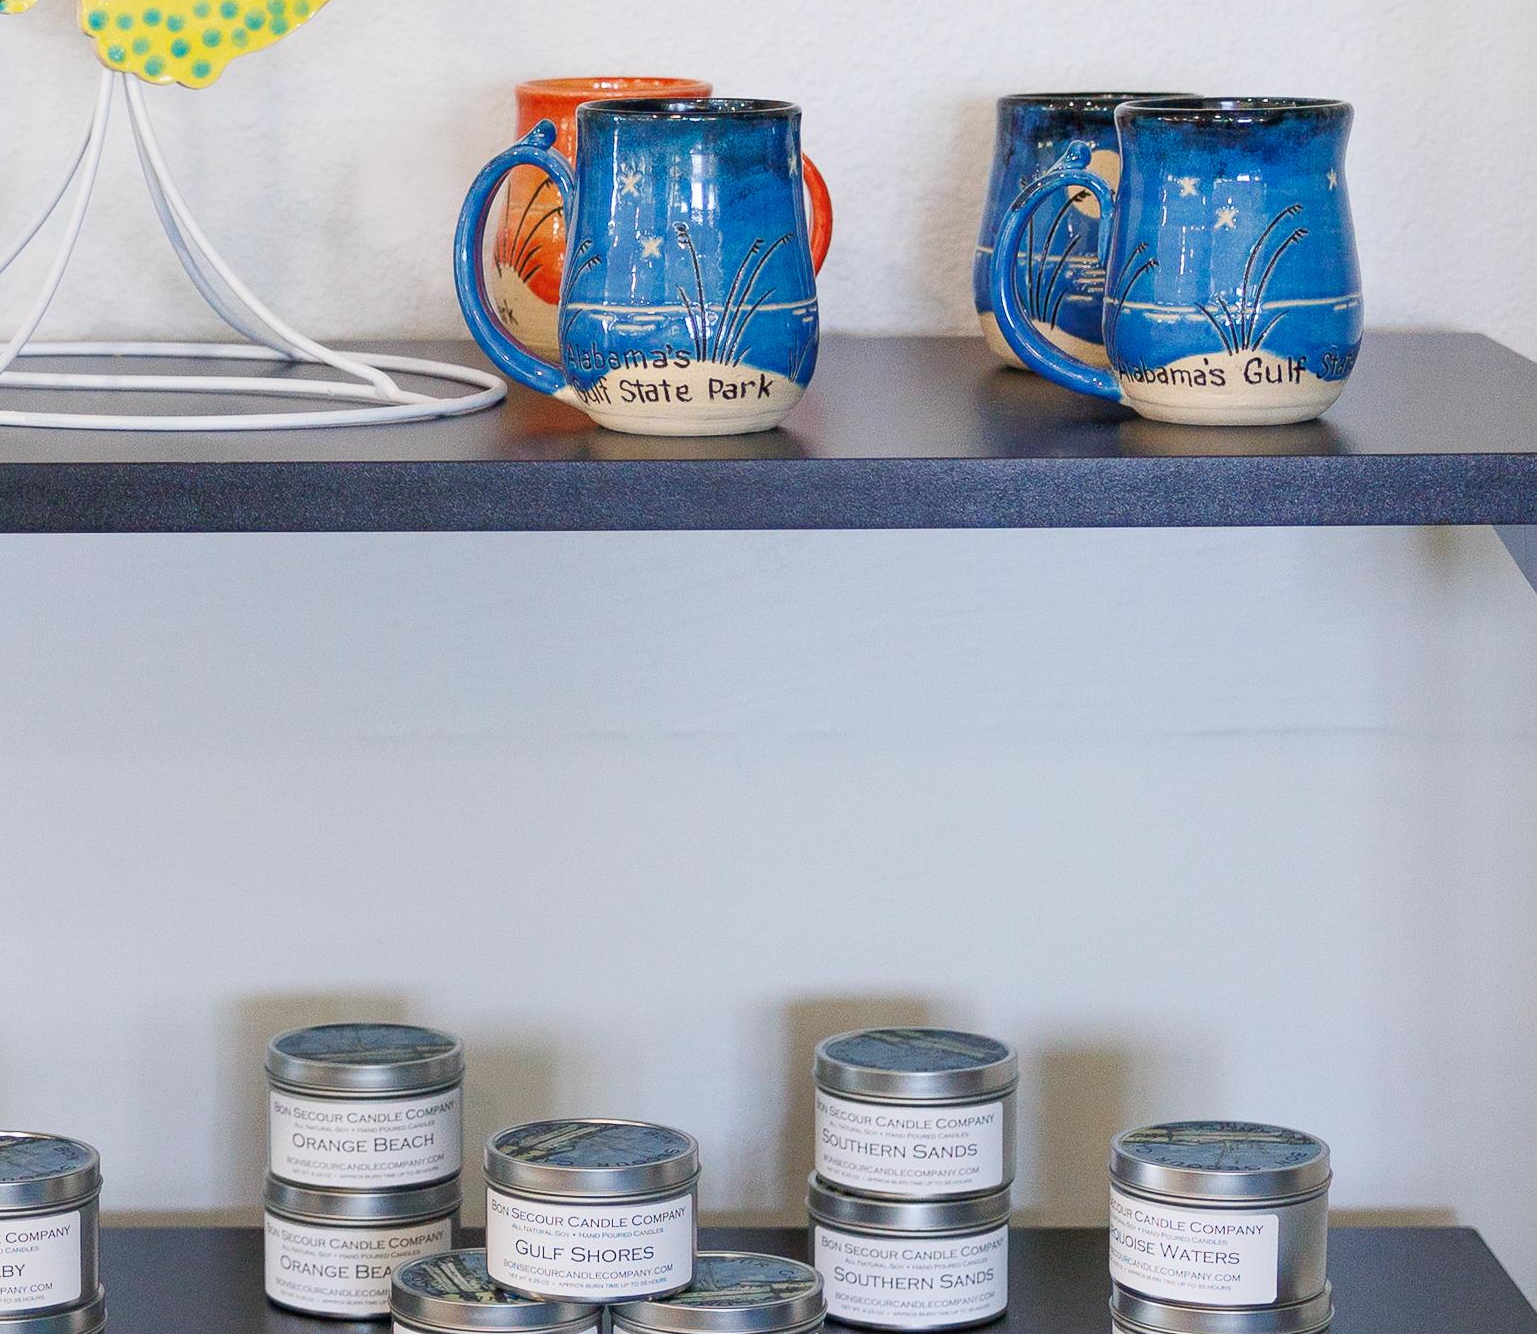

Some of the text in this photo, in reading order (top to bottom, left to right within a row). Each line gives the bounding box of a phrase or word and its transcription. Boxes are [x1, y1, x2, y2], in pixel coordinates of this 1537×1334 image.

[566, 341, 692, 371] Alabama's
[1118, 357, 1226, 387] Alabama's
[1243, 356, 1308, 384] Gulf
[572, 373, 774, 406] Gulf State Park
[292, 1133, 435, 1153] ORANGE BEACH
[913, 1144, 978, 1159] SANDS
[515, 1239, 655, 1263] GULF SHORES
[1161, 1243, 1240, 1265] WATERS
[279, 1254, 350, 1279] ORANGE
